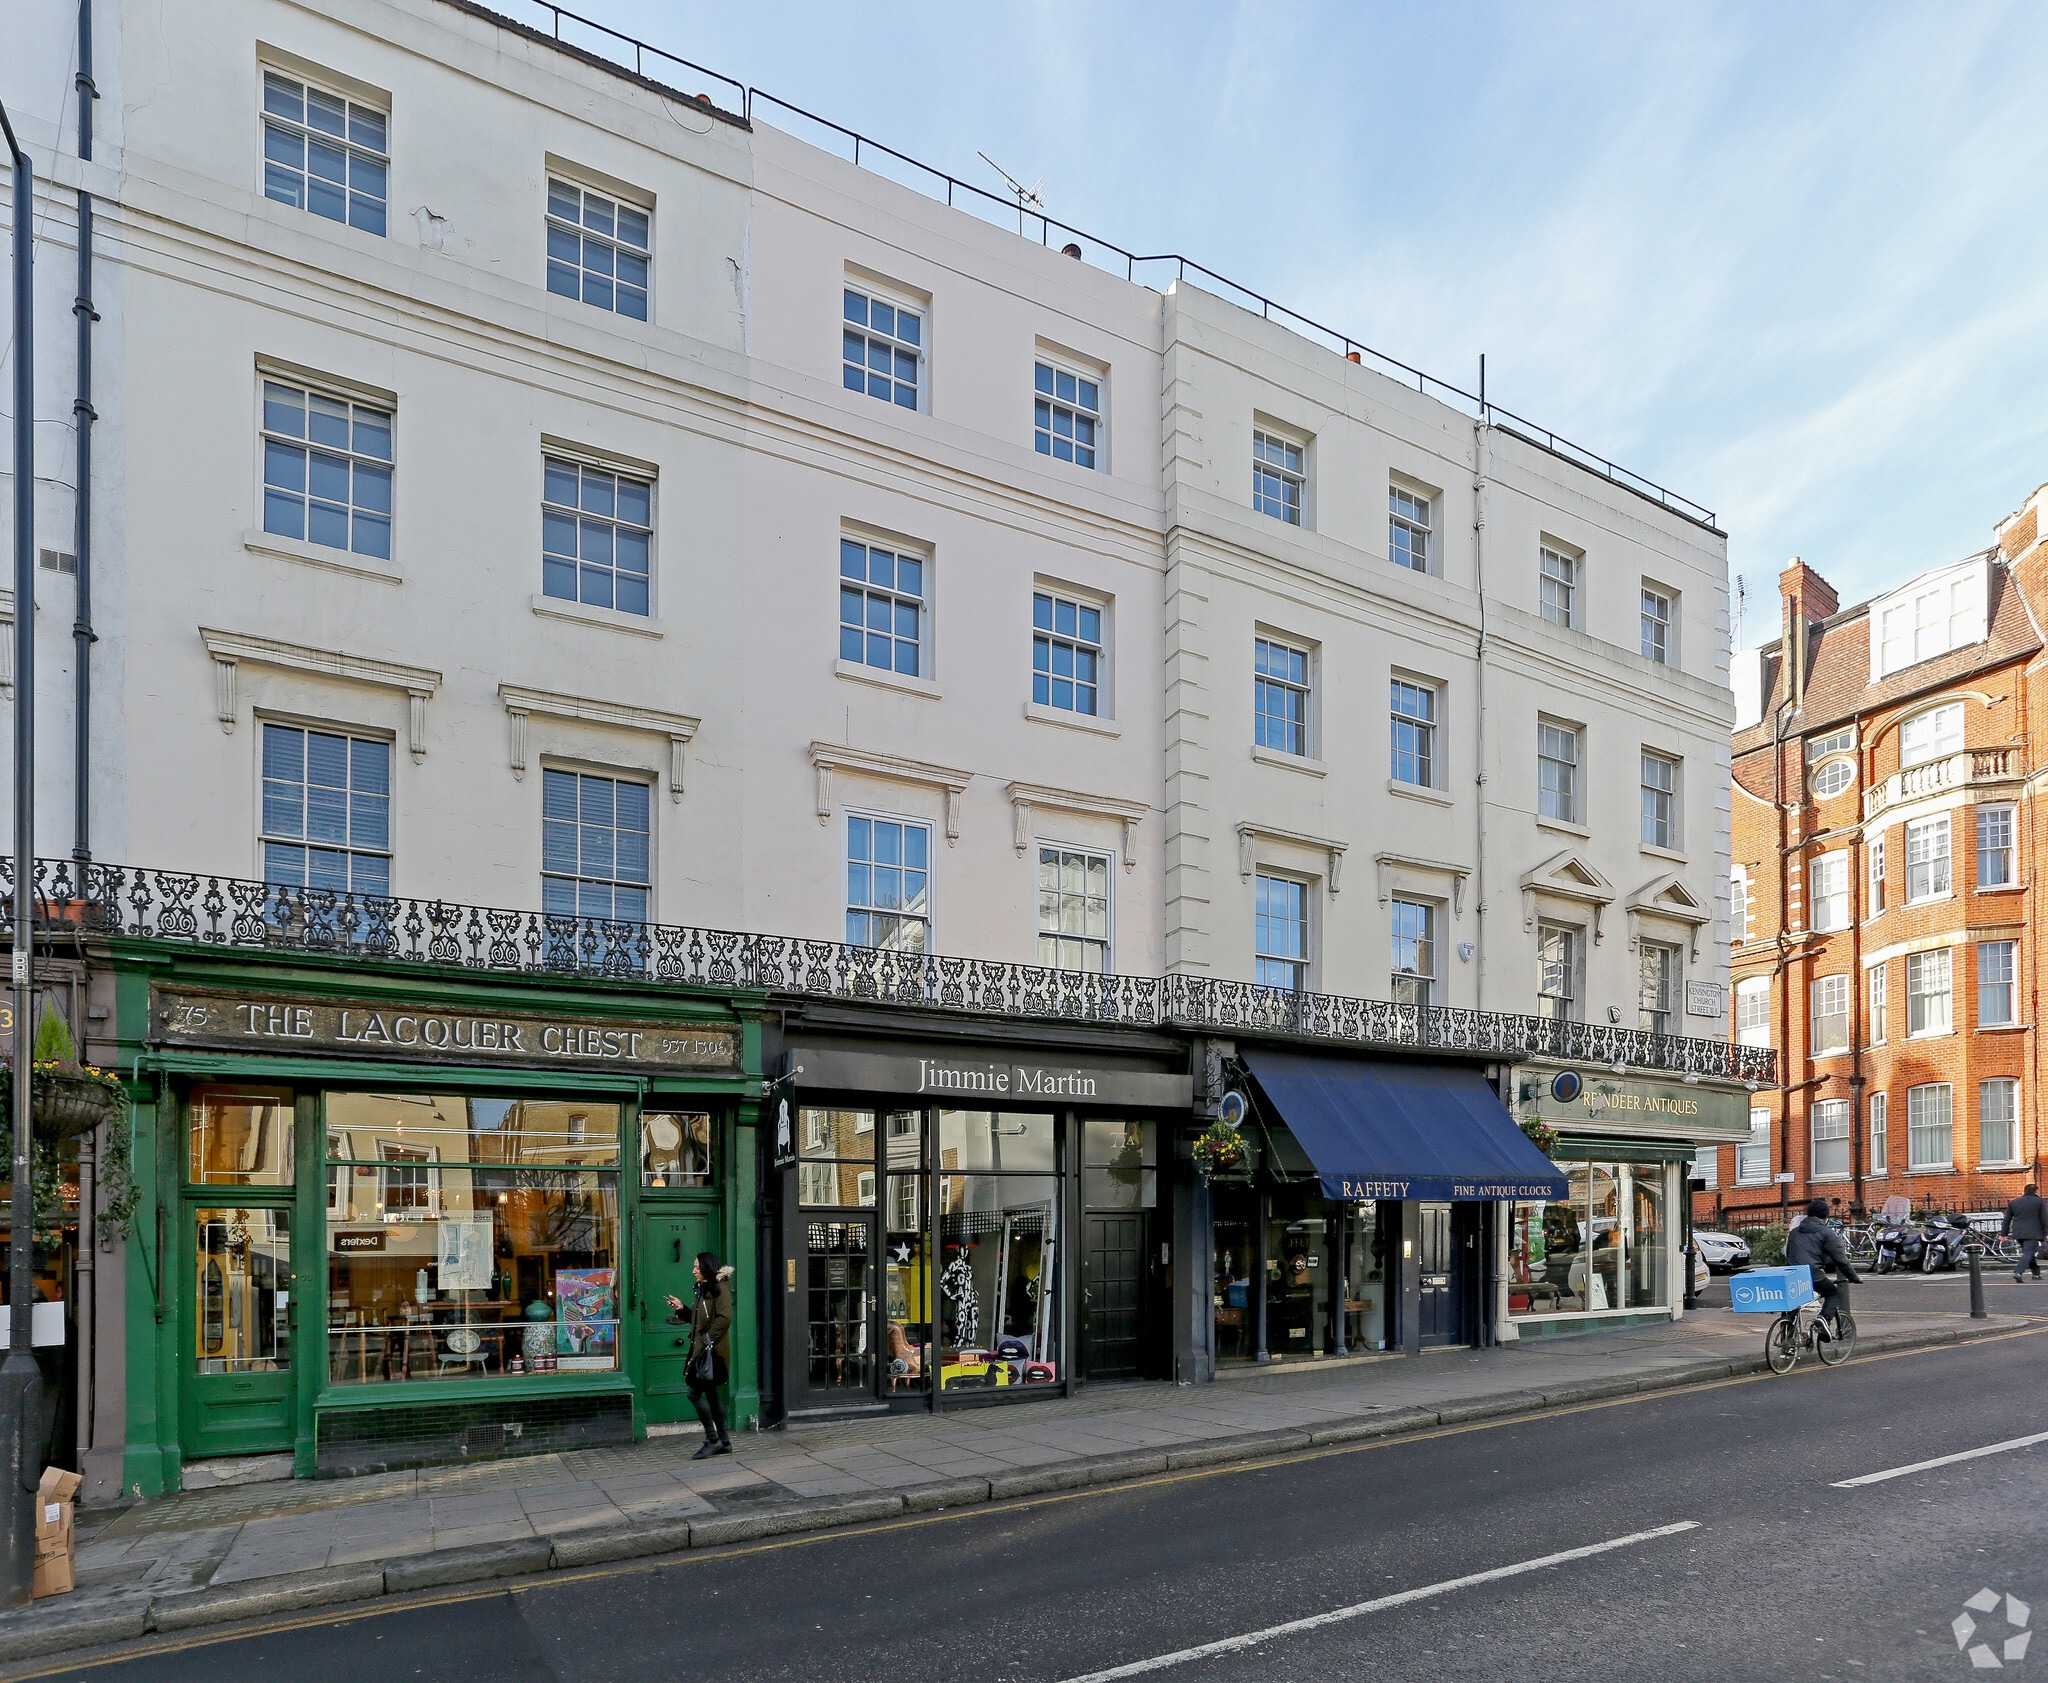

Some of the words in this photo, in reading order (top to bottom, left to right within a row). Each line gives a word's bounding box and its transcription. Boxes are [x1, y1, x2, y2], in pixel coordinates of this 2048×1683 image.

[1689, 987, 1720, 998] KENSINGTON
[1693, 996, 1716, 1006] CHURCH
[180, 1006, 208, 1026] 75
[1691, 1005, 1709, 1014] STREET
[236, 1004, 314, 1039] THE
[335, 1010, 527, 1052] LACQUER
[539, 1027, 643, 1060] CHEST
[662, 1039, 688, 1054] 937
[694, 1040, 727, 1055] 1306
[917, 1060, 1009, 1093] Jimmie
[1017, 1068, 1097, 1096] Martin
[1643, 1097, 1698, 1115] ANTIQUES
[1342, 1181, 1410, 1197] RAFFETY
[1453, 1185, 1475, 1196] FINE
[1478, 1185, 1517, 1197] ANTIQUE
[1519, 1186, 1552, 1196] CLOCKS
[1755, 1286, 1784, 1302] Jinn
